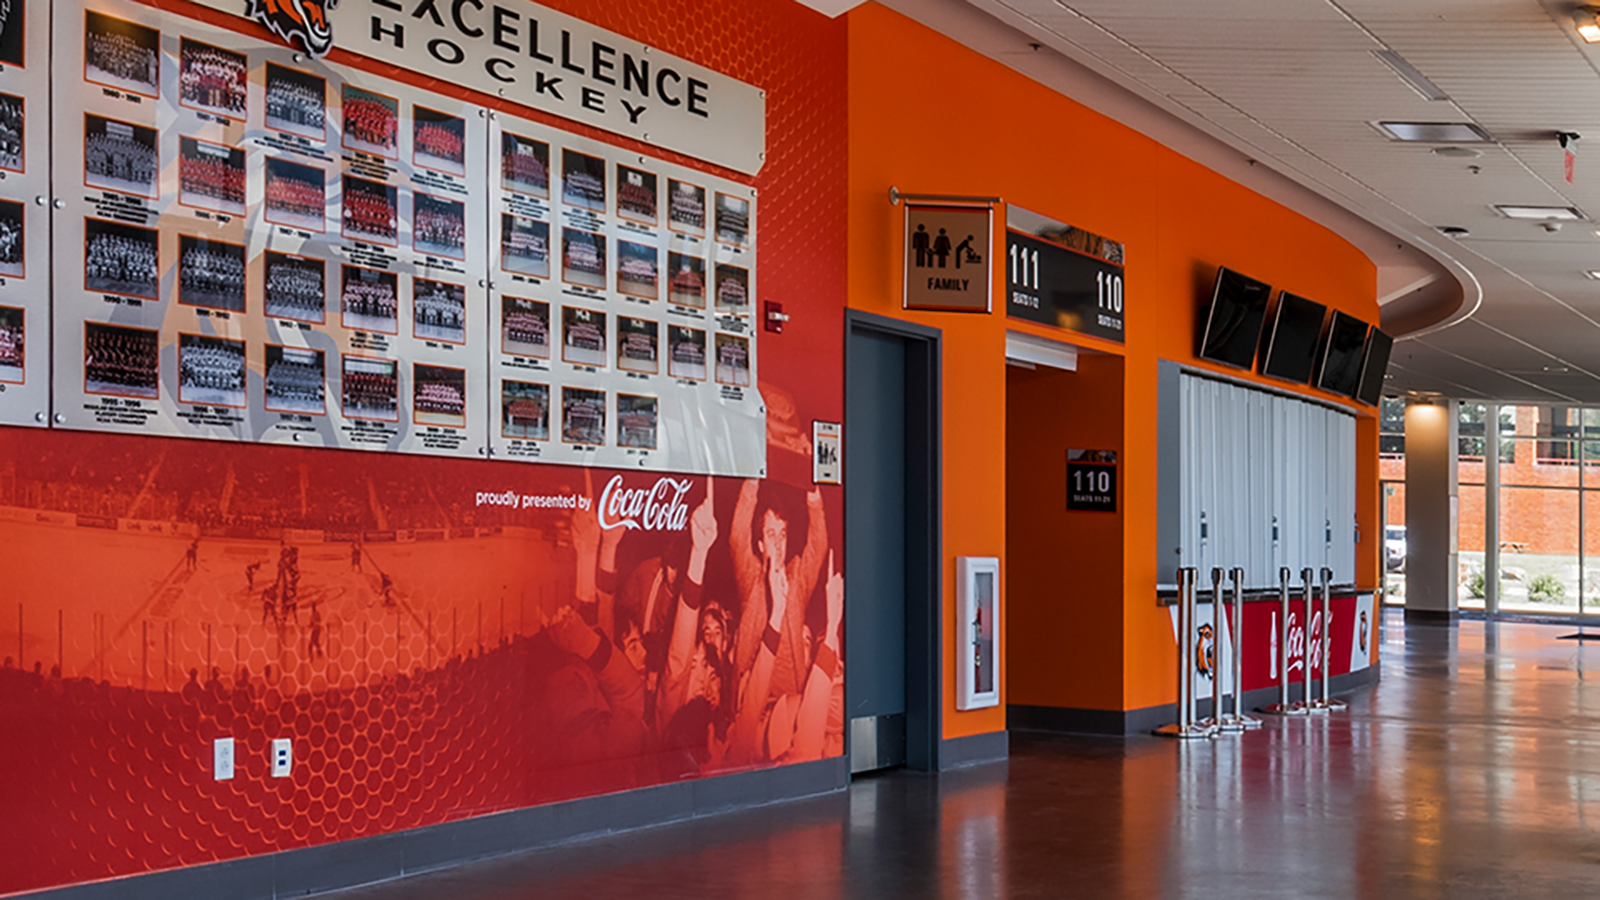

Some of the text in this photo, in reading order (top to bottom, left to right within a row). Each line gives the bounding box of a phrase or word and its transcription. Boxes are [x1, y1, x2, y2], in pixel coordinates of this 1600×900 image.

[370, 0, 709, 118] XCELLENCE
[370, 15, 647, 124] HOCKEY
[927, 277, 970, 291] FAMILY
[1009, 243, 1122, 313] 111 110
[476, 490, 591, 511] proudly presented by
[598, 474, 693, 531] Coca-Cola
[1073, 470, 1110, 493] 110
